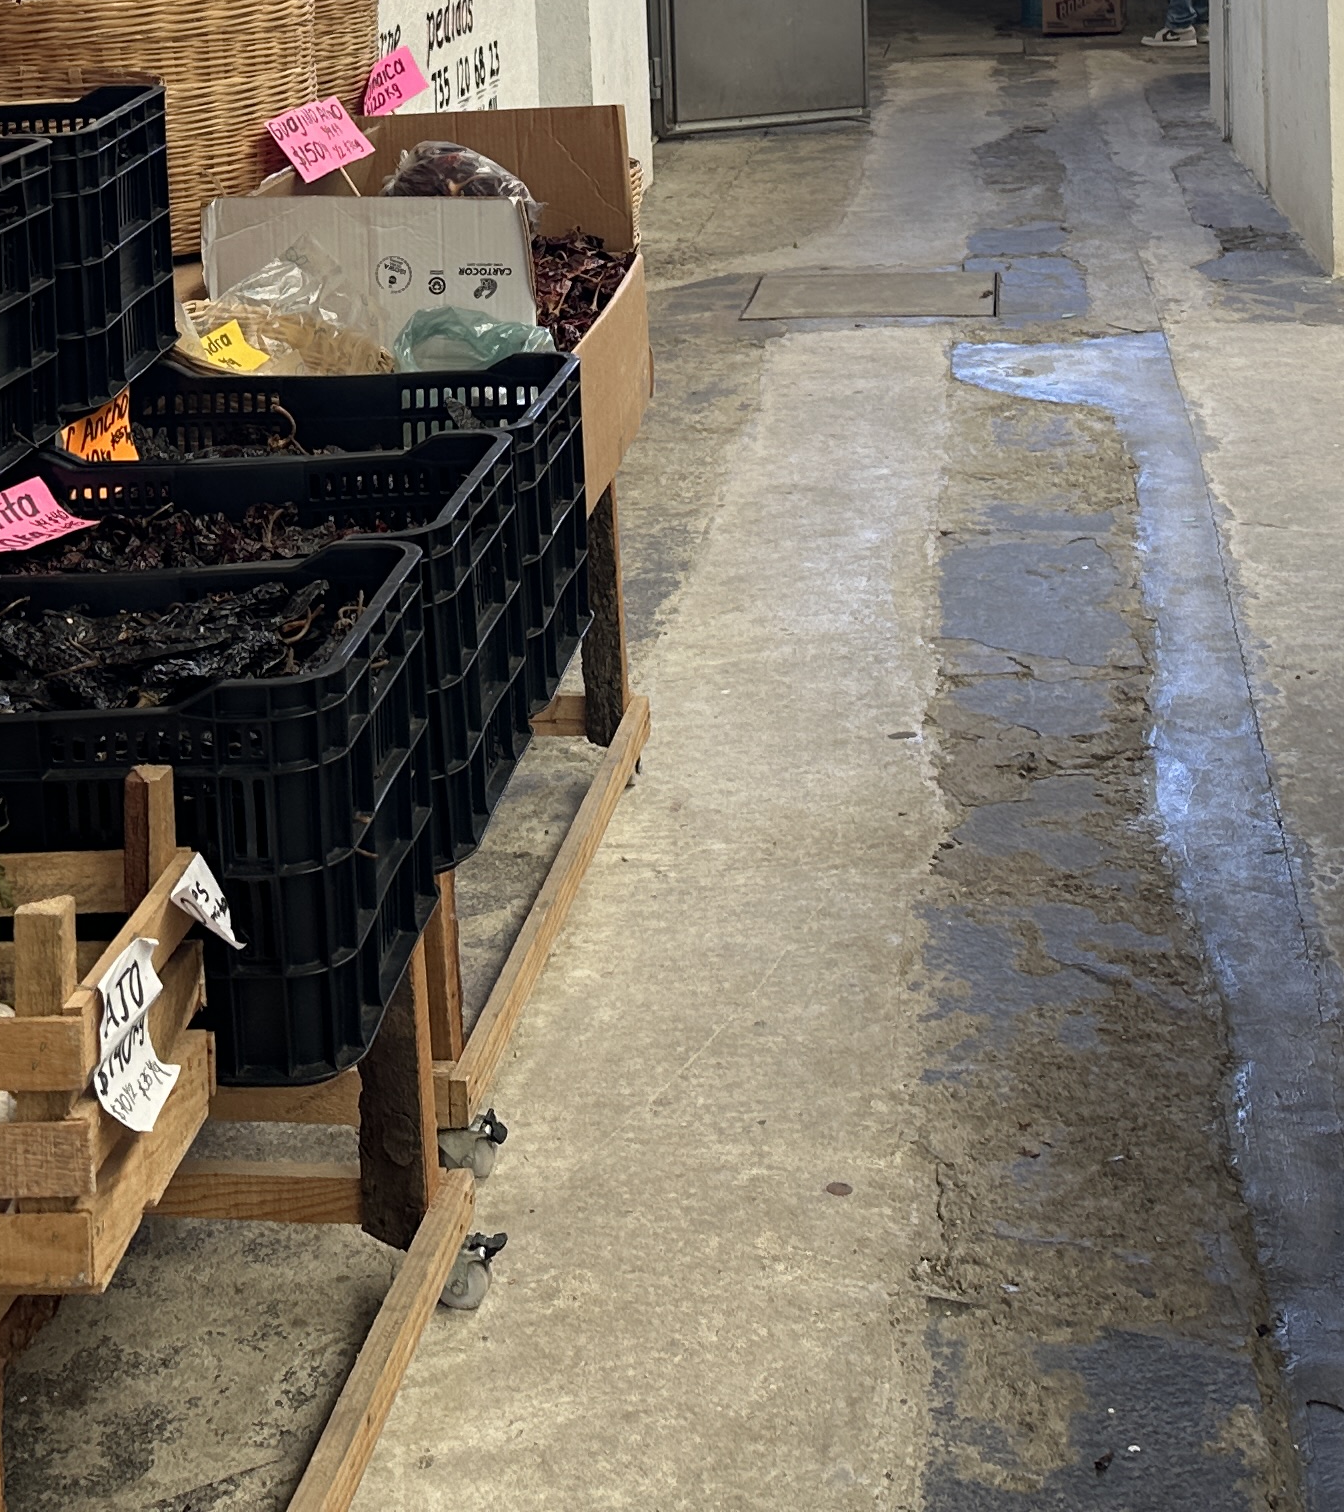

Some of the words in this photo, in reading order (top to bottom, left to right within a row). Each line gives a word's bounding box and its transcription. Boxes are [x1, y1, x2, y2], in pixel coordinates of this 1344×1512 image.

[431, 66, 450, 113] 735
[474, 45, 486, 89] 68
[458, 267, 513, 276] CARTOCOR
[80, 393, 129, 453] Ancho
[104, 959, 144, 1039] AJO
